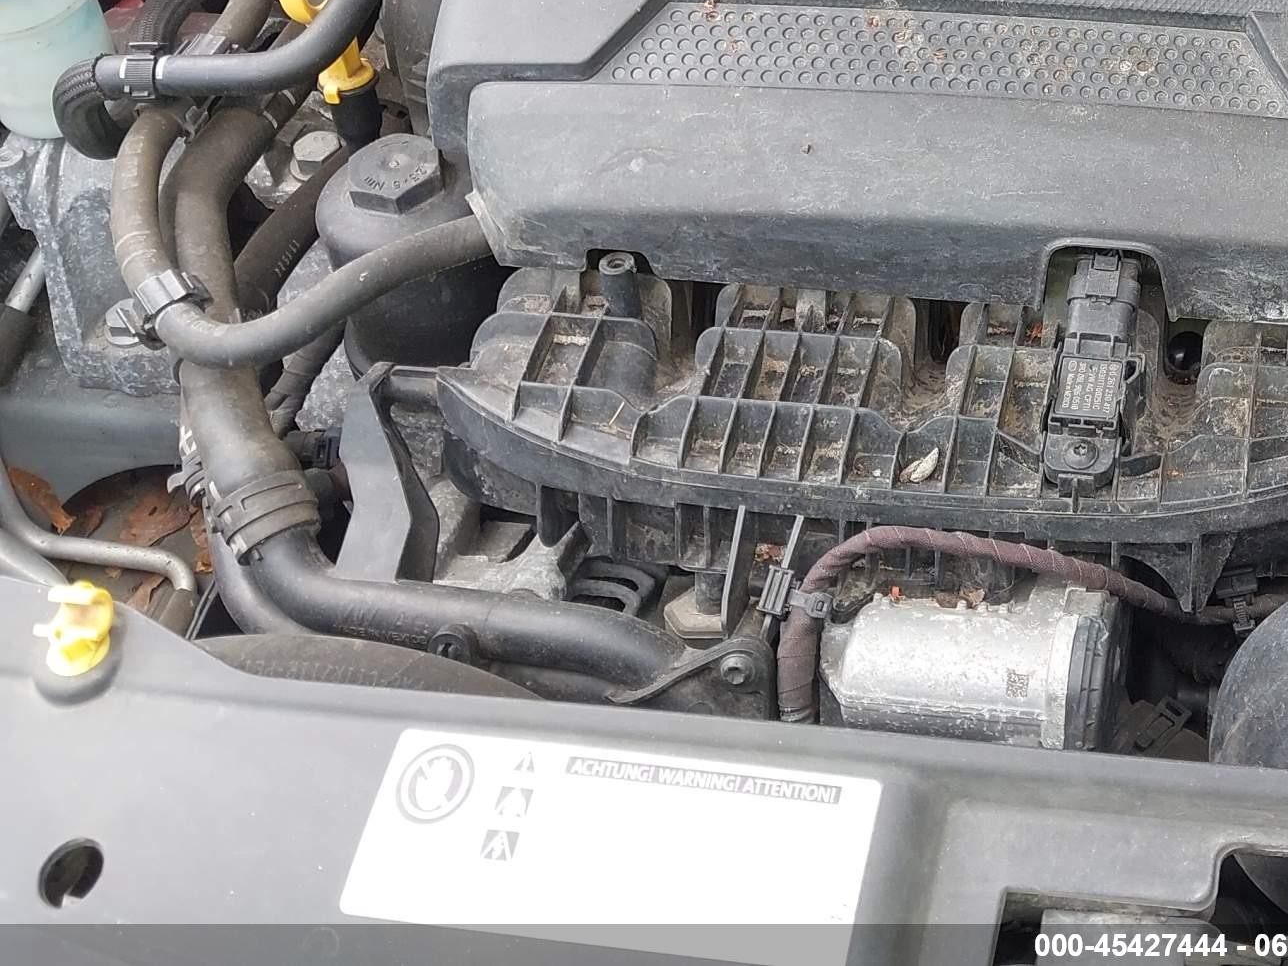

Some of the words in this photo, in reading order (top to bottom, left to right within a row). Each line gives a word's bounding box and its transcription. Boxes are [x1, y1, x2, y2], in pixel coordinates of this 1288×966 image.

[570, 758, 656, 783] ACHTUNG!
[658, 768, 740, 793] WARNING!
[742, 777, 838, 804] ATTENTION!
